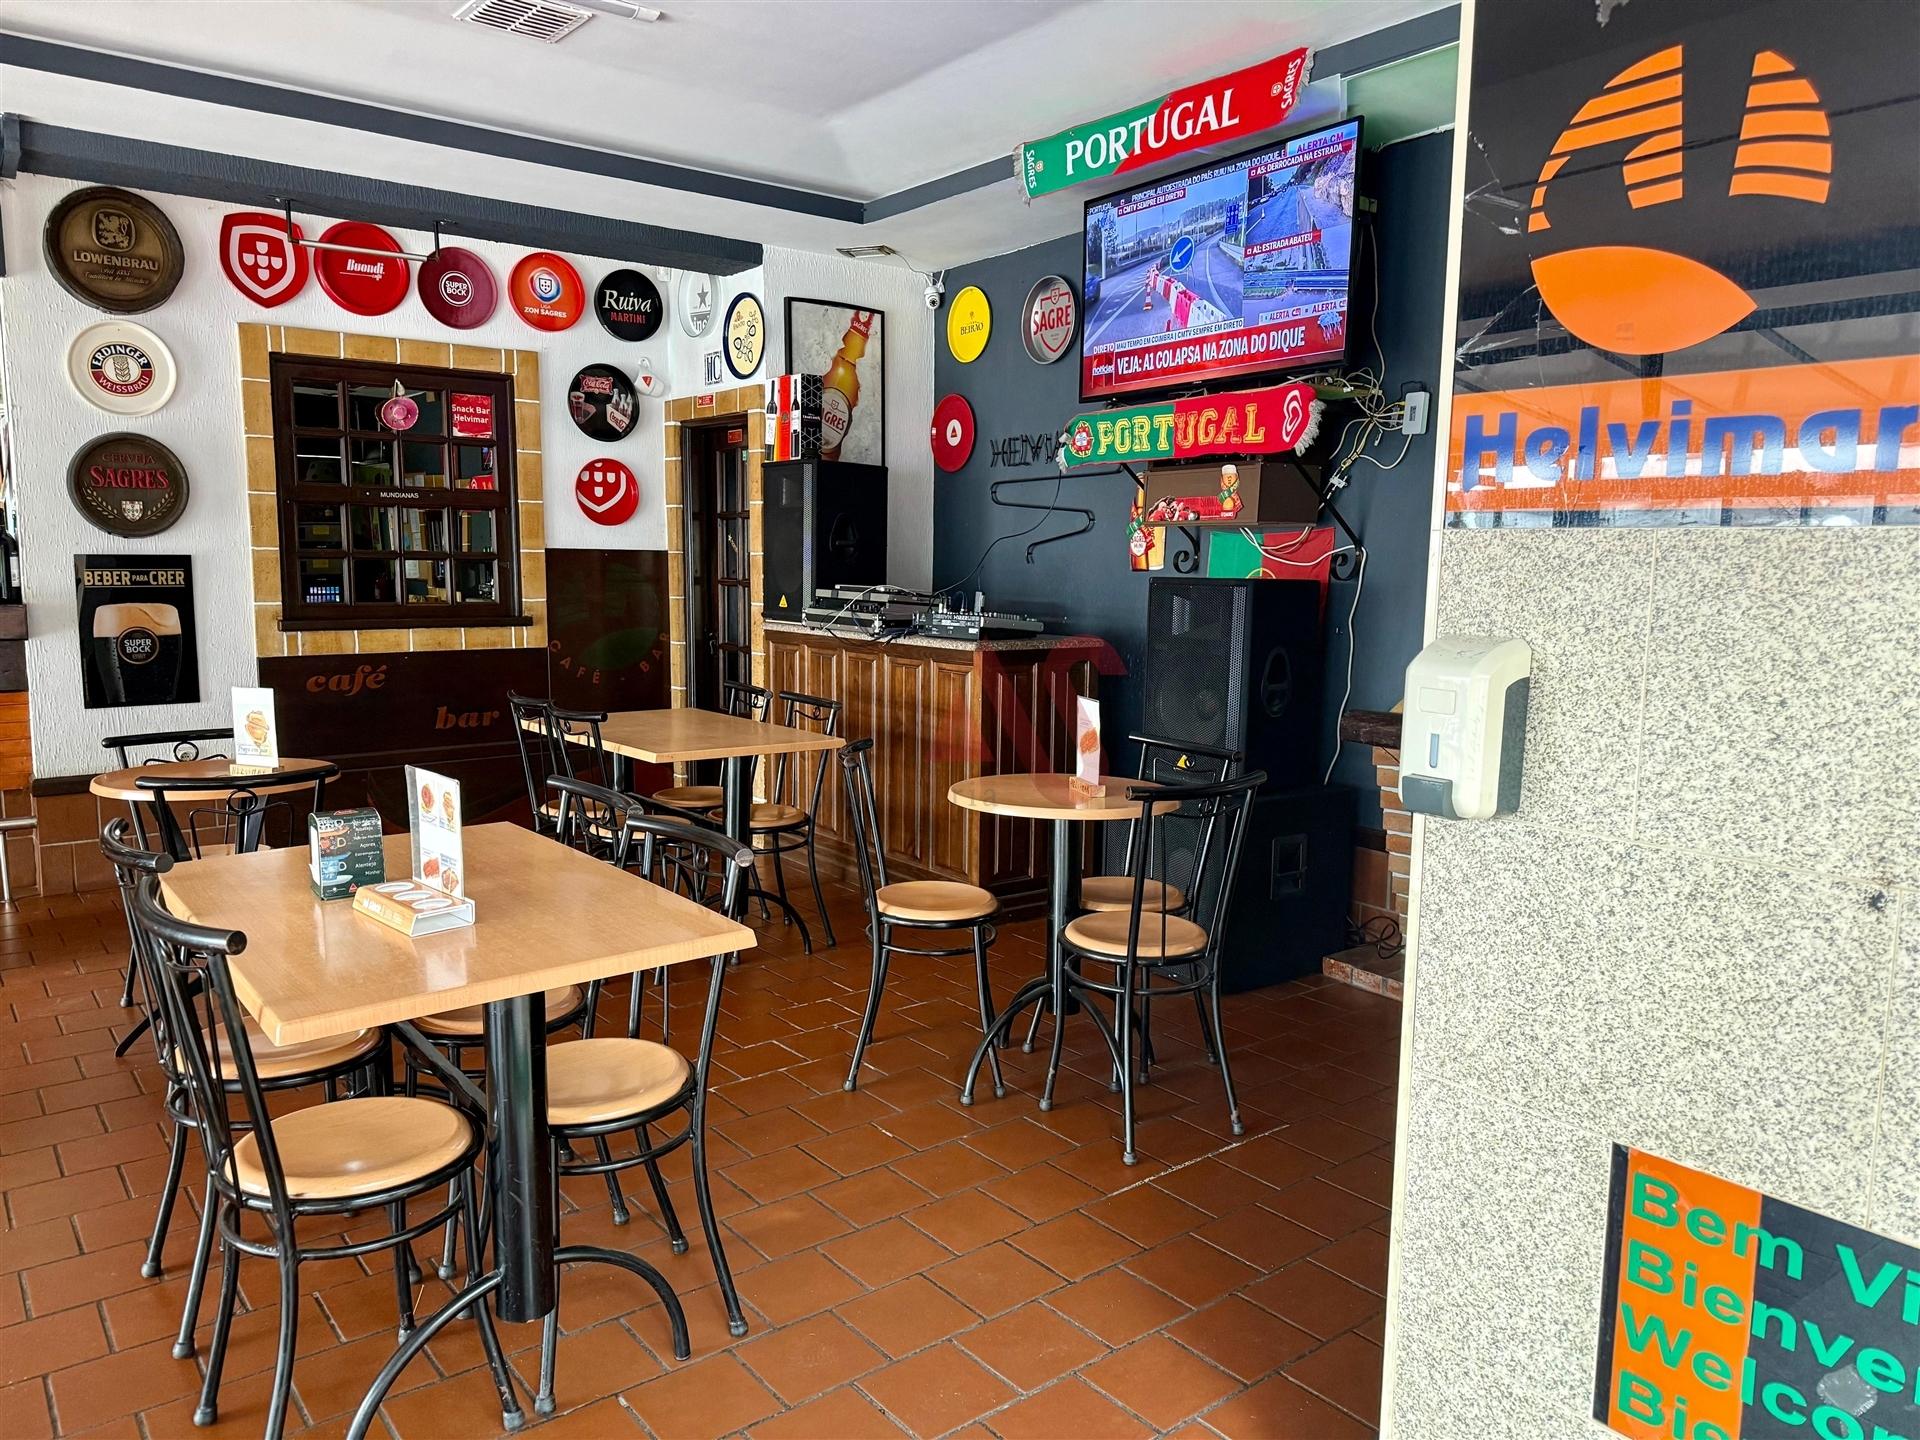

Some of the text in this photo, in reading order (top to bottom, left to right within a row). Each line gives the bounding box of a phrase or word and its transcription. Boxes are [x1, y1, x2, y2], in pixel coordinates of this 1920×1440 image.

[1280, 58, 1301, 109] SAGRES
[1066, 88, 1239, 176] PORTUGAL
[1297, 132, 1344, 154] ALERTA CM
[1026, 149, 1037, 189] SAGRES
[1267, 156, 1303, 173] DERROCADA
[1303, 152, 1314, 163] NA
[1314, 143, 1343, 160] ESTRADA
[1156, 178, 1192, 195] AUTOESTRADA
[1227, 163, 1236, 174] NA
[1236, 160, 1251, 173] ZONA
[1251, 157, 1261, 168] DO
[1123, 190, 1184, 214] CMTV SEMPRE EM DIRETO
[1262, 238, 1288, 251] ESTRADA
[1289, 233, 1313, 246] ABATEU
[445, 280, 468, 291] SUPER
[446, 287, 467, 296] BOCK
[523, 306, 567, 318] ZON SAGRES
[602, 289, 652, 313] Ruiva
[1269, 310, 1290, 321] ALERTA
[1312, 300, 1337, 314] ALERTA
[610, 312, 646, 324] MARTINI
[1033, 303, 1072, 336] SAGRE
[1127, 339, 1143, 348] TEMPO
[1177, 330, 1191, 340] CMTV
[1192, 325, 1213, 336] SEMPRE
[1214, 322, 1223, 332] EM
[1223, 318, 1242, 330] DIRETO
[92, 345, 148, 366] ERDINGER
[1093, 342, 1115, 355] DIRETO
[1117, 325, 1305, 375] VEJA: A1 COLAPSA NA ZONA DO DIQUE
[452, 404, 491, 415] Snack Bar
[454, 414, 489, 424] Helvimar
[822, 407, 846, 431] GRES
[1097, 403, 1264, 455] PORTUGAL
[1462, 400, 1920, 493] Helvimar
[102, 453, 156, 465] CERVEJA
[90, 466, 169, 488] SAGRES
[380, 491, 419, 499] MUNDIANAS
[84, 571, 131, 586] BEBER
[149, 571, 184, 585] CRER
[124, 639, 152, 647] SUPER
[126, 646, 151, 654] BOCK
[306, 663, 386, 697] café
[435, 706, 500, 731] bar
[1631, 1171, 1803, 1281] Bem
[1627, 1238, 1920, 1406] Bienve
[1620, 1302, 1908, 1440] Welco
